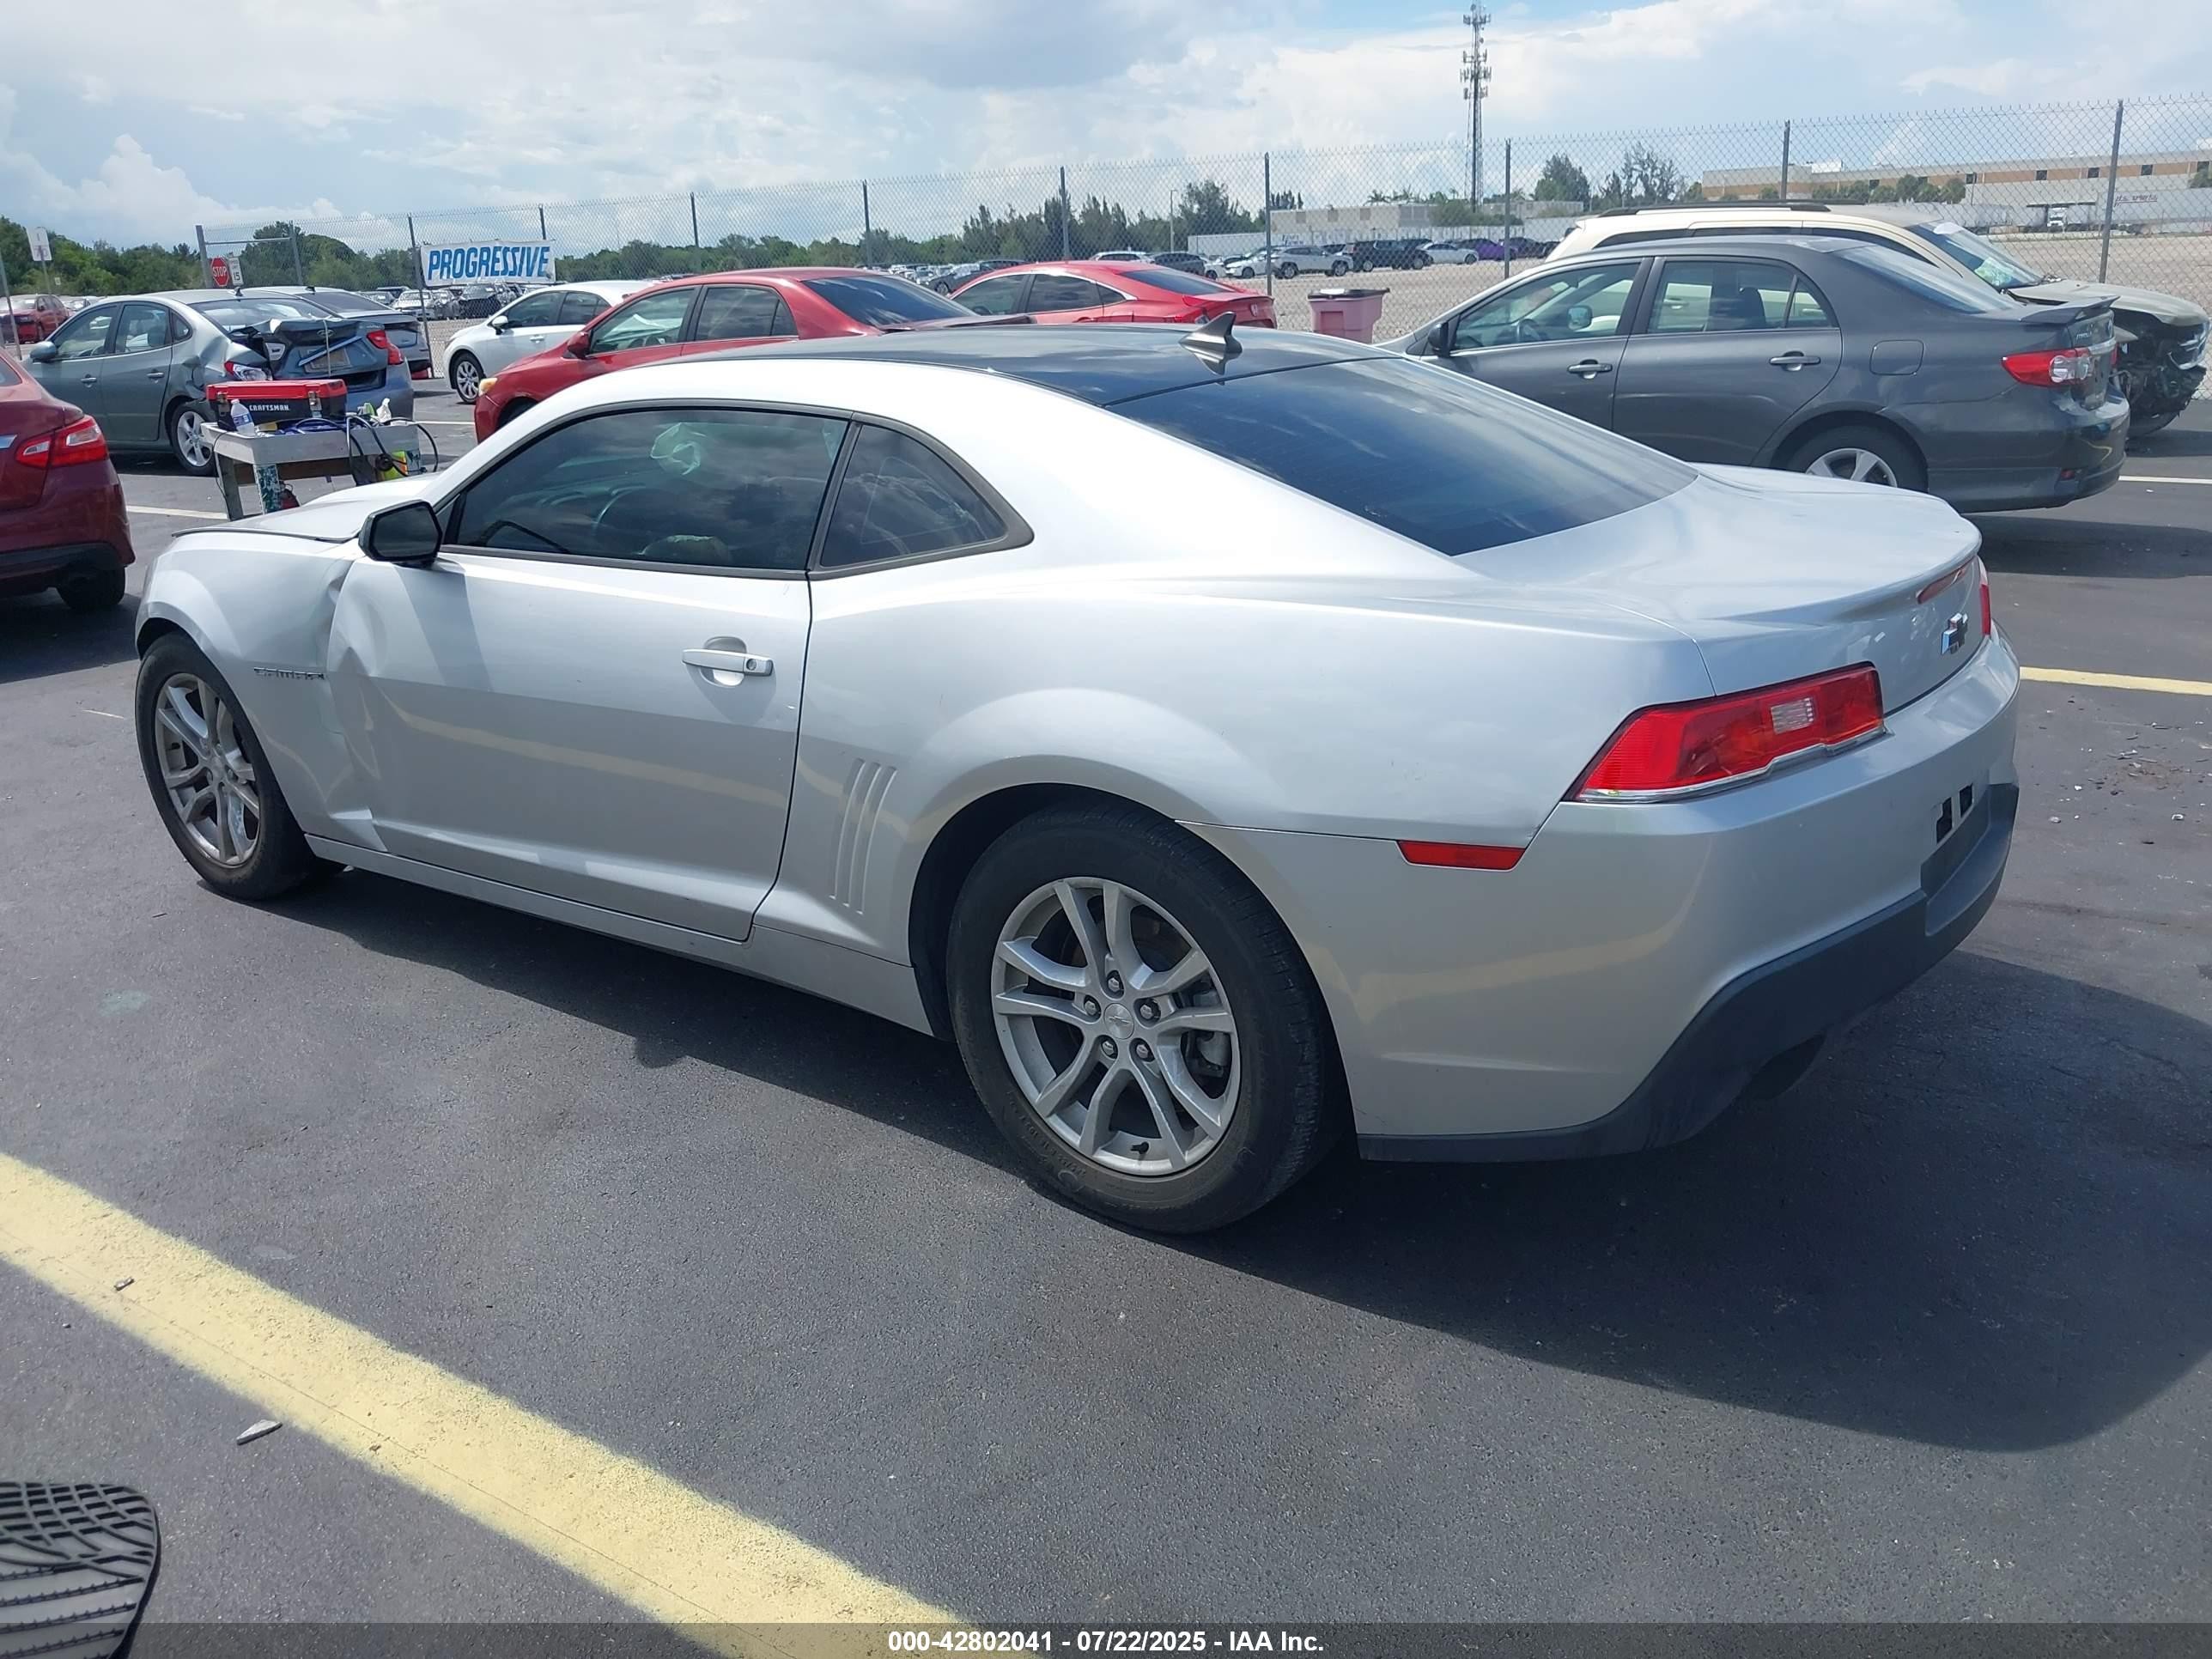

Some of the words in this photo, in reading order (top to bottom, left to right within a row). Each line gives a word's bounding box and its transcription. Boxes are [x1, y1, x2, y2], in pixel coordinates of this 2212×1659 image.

[428, 246, 550, 281] PROGRESSIVE
[212, 266, 228, 277] STOP
[233, 271, 240, 281] 15
